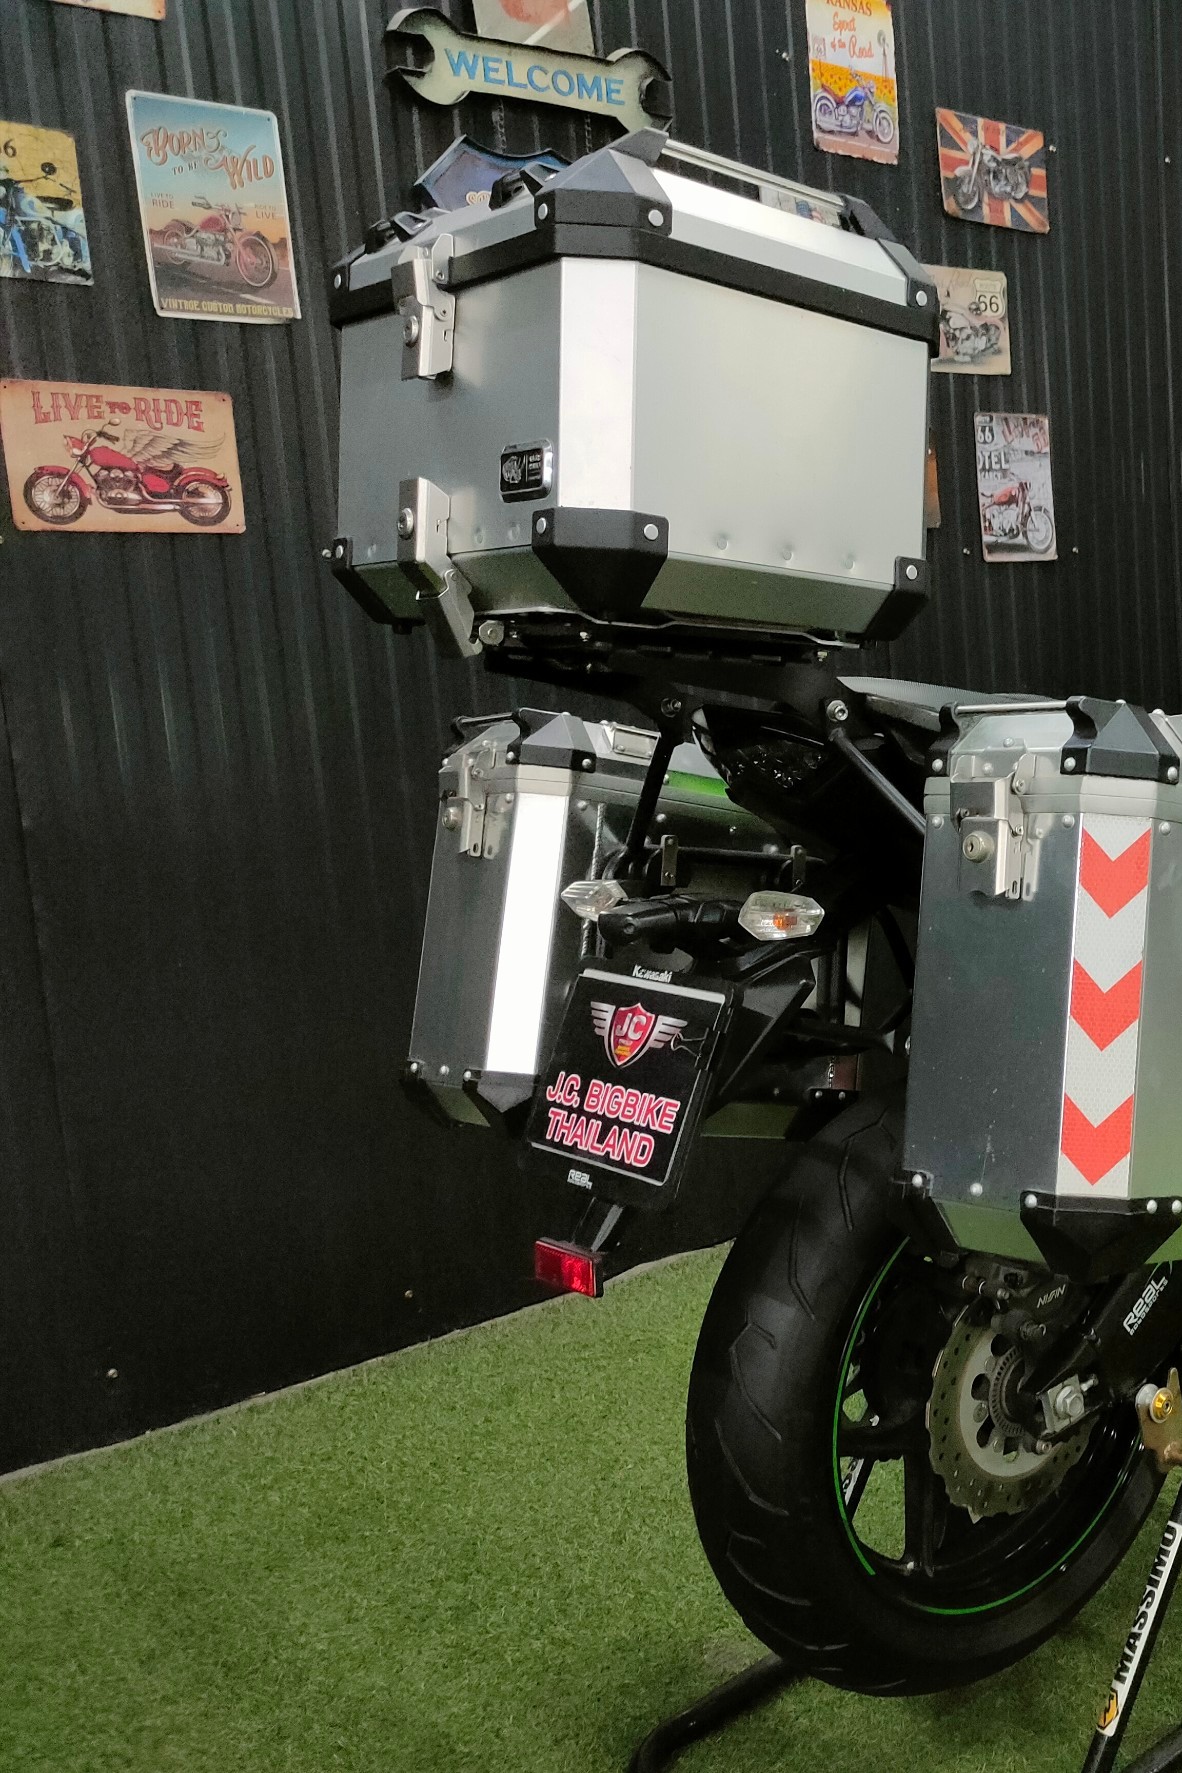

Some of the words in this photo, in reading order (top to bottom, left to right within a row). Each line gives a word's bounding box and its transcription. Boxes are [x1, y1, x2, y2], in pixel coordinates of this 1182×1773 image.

[443, 48, 625, 106] WELCOME
[152, 198, 175, 210] RIDE
[255, 210, 276, 220] LIVE
[978, 294, 999, 313] 66
[31, 390, 106, 425] LIVE
[106, 399, 131, 415] TO
[133, 396, 205, 433] RIDE
[632, 963, 673, 984] Kawasaki
[615, 1012, 647, 1040] JC
[546, 1070, 581, 1109] J.C.
[583, 1078, 681, 1135] BIGBIKE
[545, 1107, 656, 1169] THAILAND
[1113, 1523, 1178, 1685] MASSIMO
